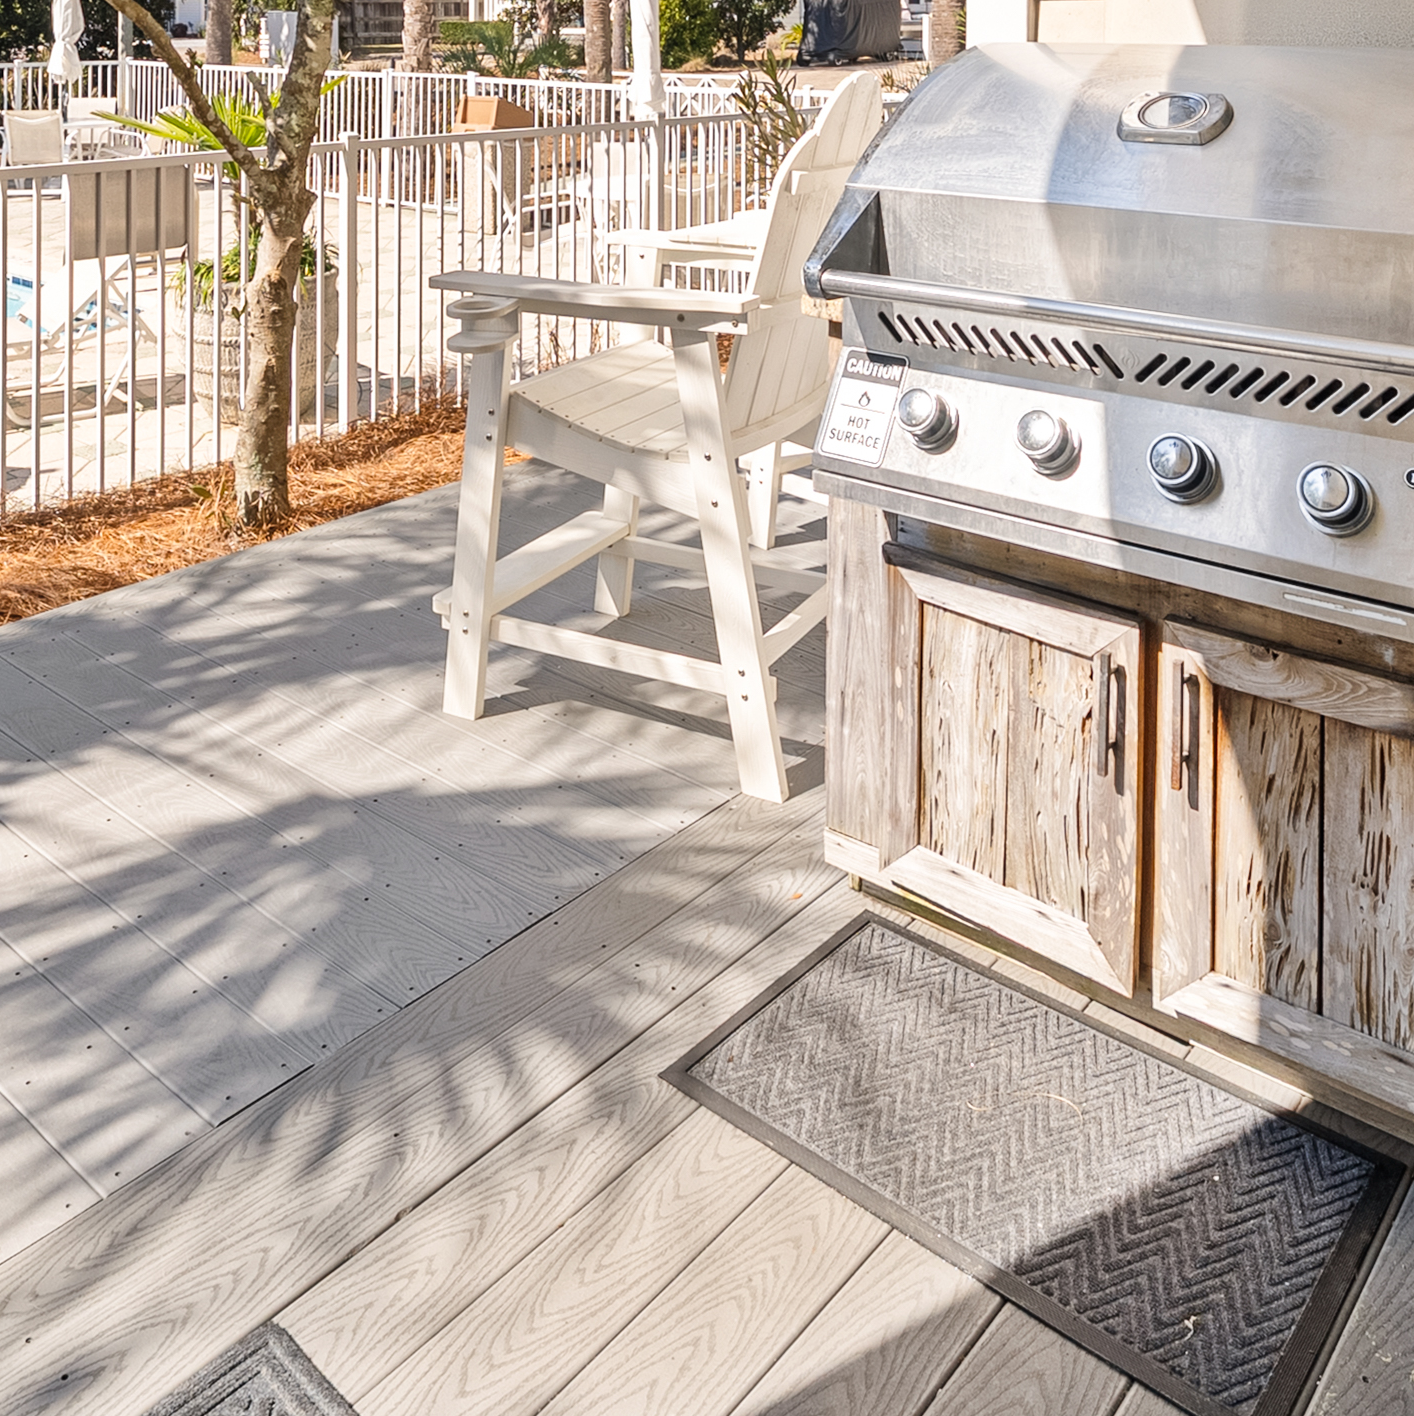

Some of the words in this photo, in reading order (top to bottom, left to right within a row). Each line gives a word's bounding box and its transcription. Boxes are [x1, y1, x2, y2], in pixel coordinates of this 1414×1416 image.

[846, 357, 903, 381] CAUTION
[847, 416, 871, 428] HOT
[829, 428, 881, 450] SURFACE
